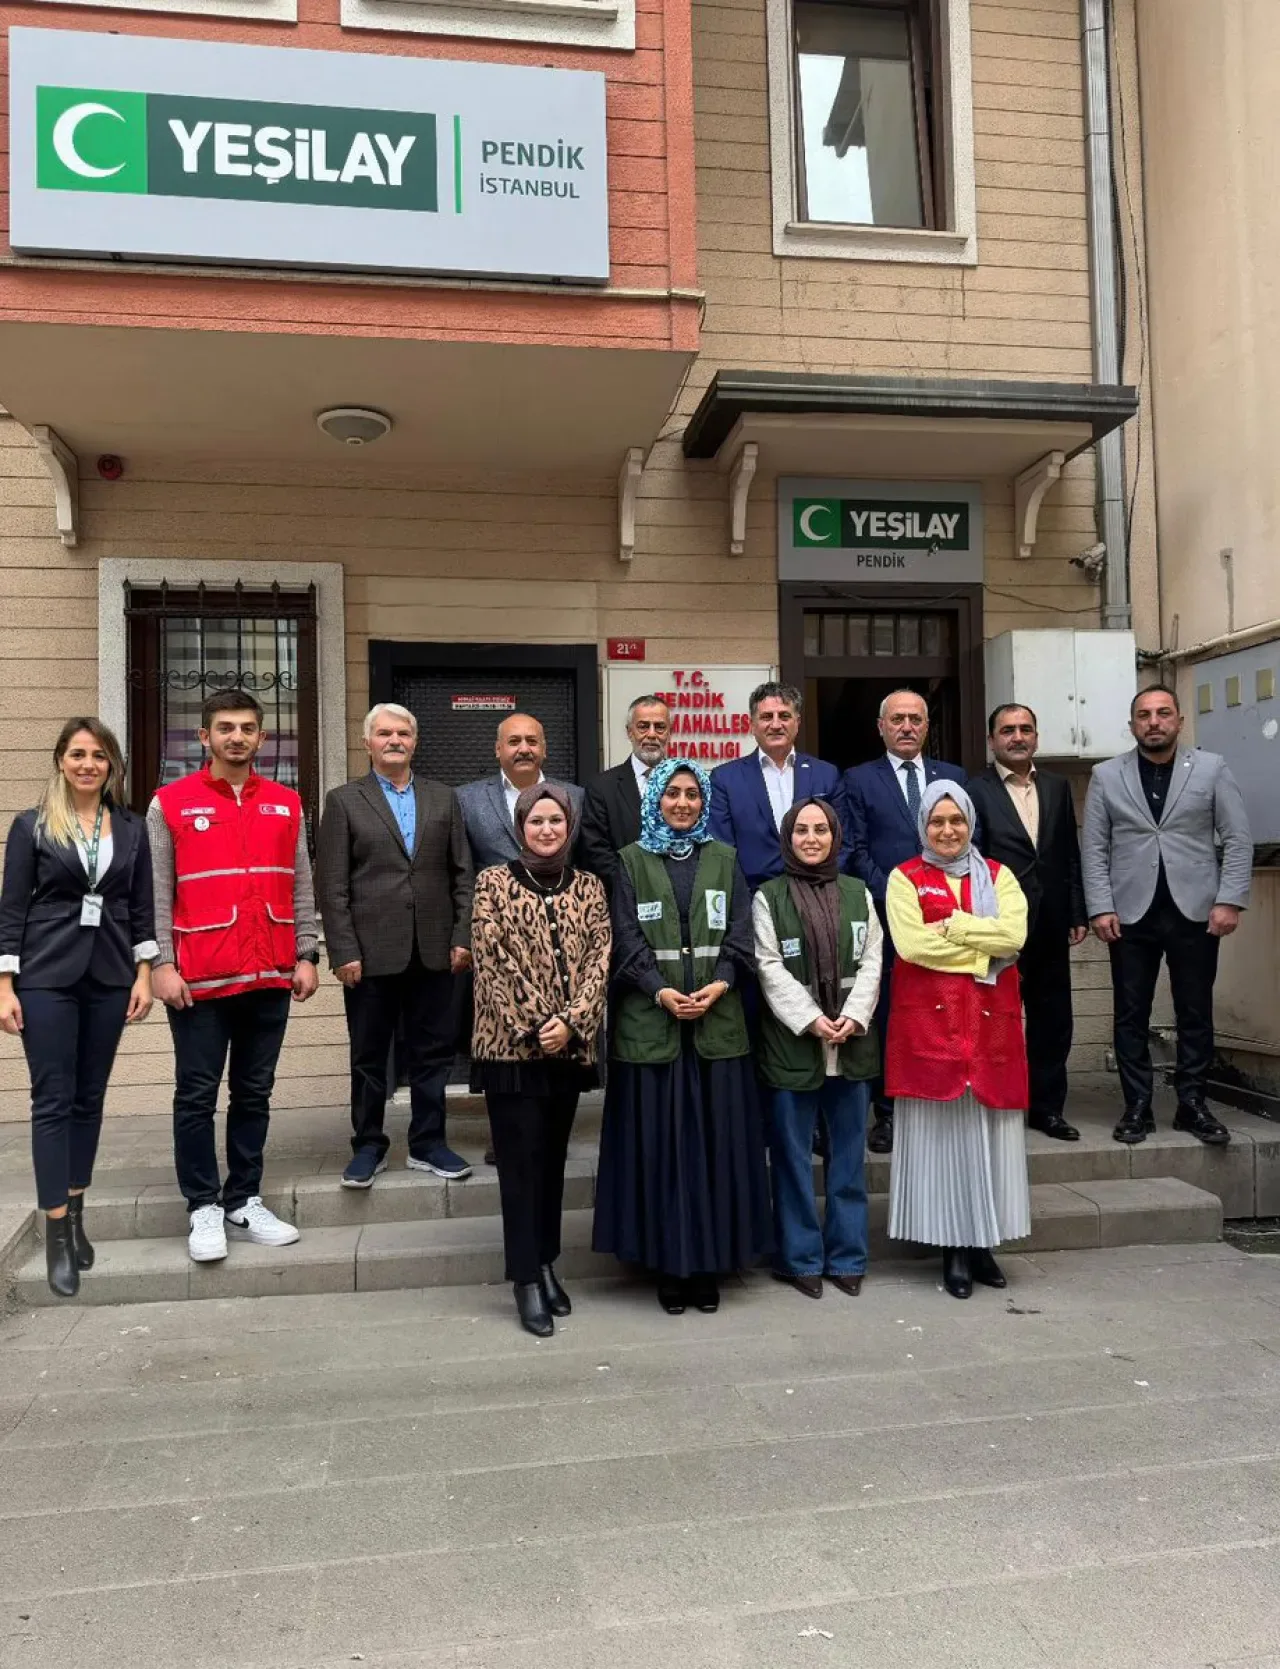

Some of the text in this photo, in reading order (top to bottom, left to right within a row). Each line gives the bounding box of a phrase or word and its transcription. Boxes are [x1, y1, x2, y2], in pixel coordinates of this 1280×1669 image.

[481, 138, 585, 171] PENDİK
[479, 172, 580, 199] İSTANBUL
[856, 552, 905, 568] PENDİK
[673, 670, 710, 688] T.C.
[670, 713, 751, 734] MAHALLES
